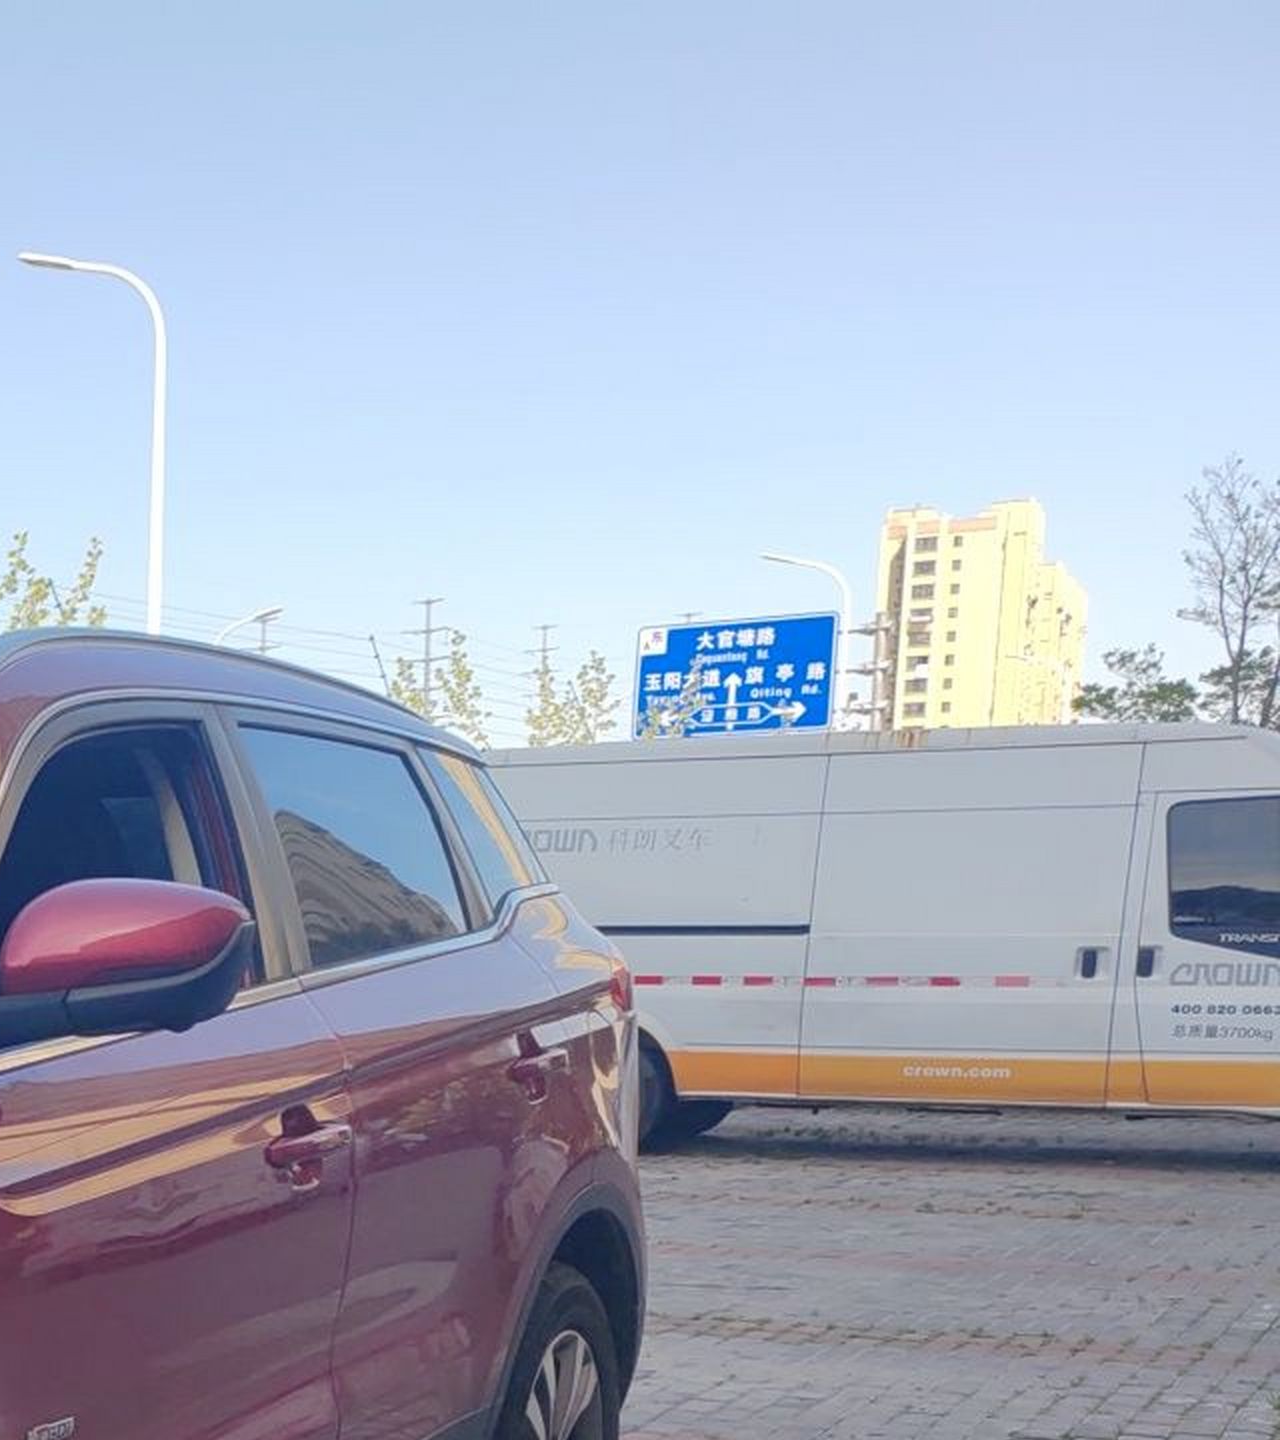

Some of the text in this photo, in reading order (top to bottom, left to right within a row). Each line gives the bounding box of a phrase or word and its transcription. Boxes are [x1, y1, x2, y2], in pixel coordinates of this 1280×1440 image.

[1171, 1004, 1202, 1015] 400
[1207, 1004, 1237, 1015] 820
[903, 1066, 1011, 1078] crown.com
